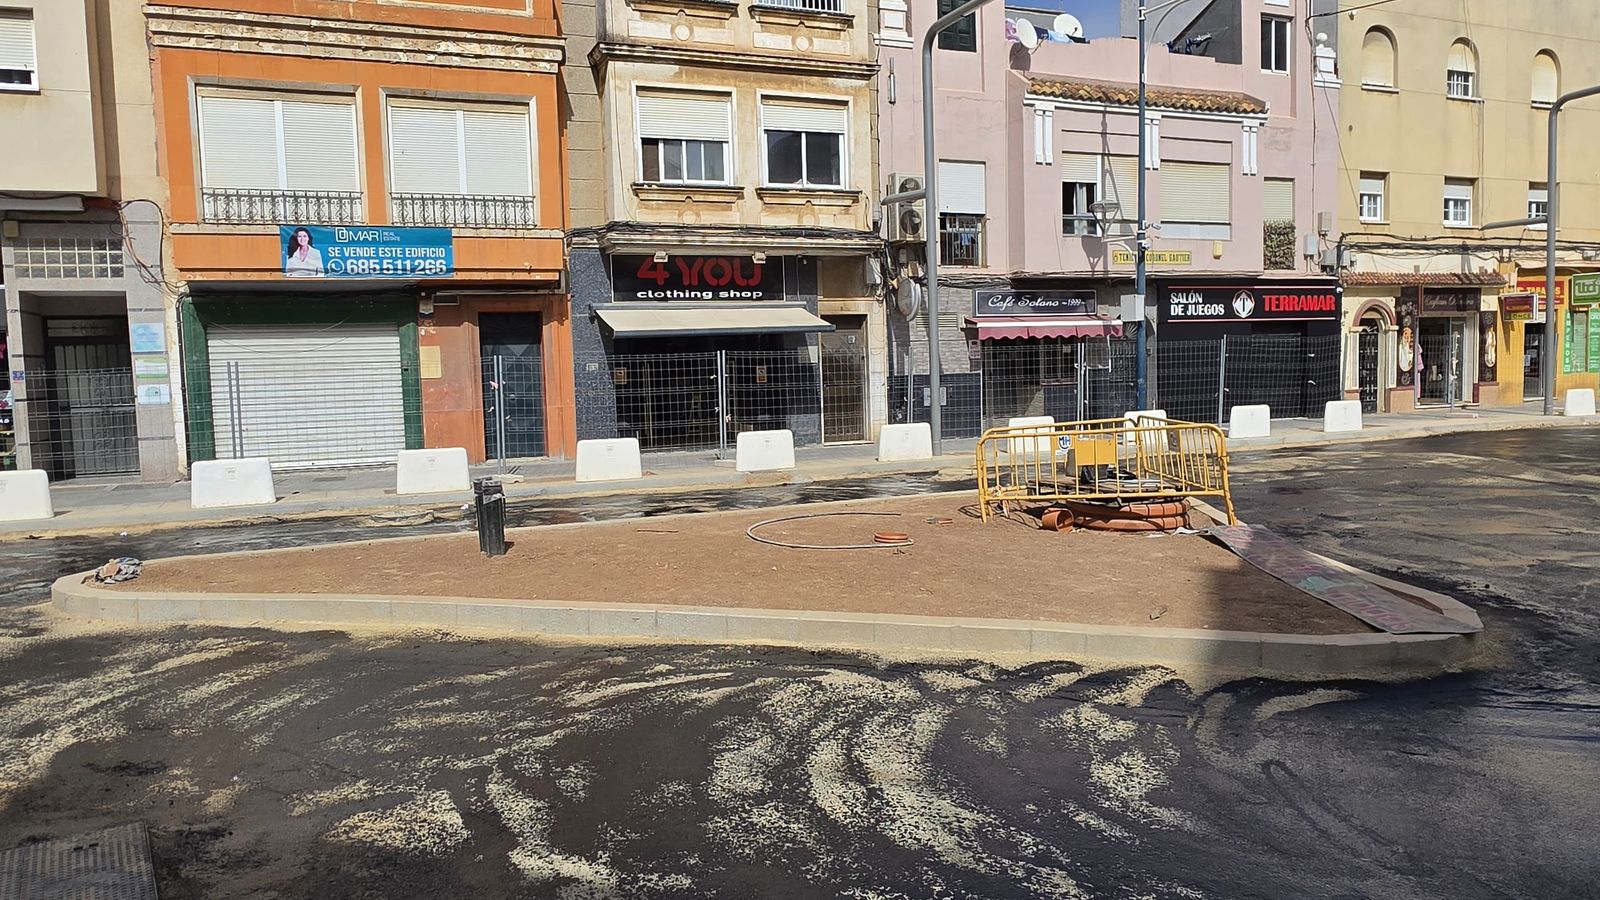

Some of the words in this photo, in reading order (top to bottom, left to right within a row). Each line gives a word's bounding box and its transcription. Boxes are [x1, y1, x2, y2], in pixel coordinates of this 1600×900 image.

[328, 247, 342, 257] SE
[343, 247, 376, 257] VENDE
[378, 247, 403, 257] ESTE
[405, 247, 445, 258] EDIFICIO
[637, 257, 670, 286] 4
[675, 257, 762, 286] YOU
[636, 289, 713, 299] clothing
[719, 290, 763, 299] shop
[1170, 290, 1203, 303] SALÓN
[988, 295, 1015, 311] Café
[1018, 294, 1059, 307] Solano
[1263, 295, 1336, 311] TERRAMAR
[1171, 304, 1185, 315] DE
[1186, 304, 1225, 315] JUEGOS
